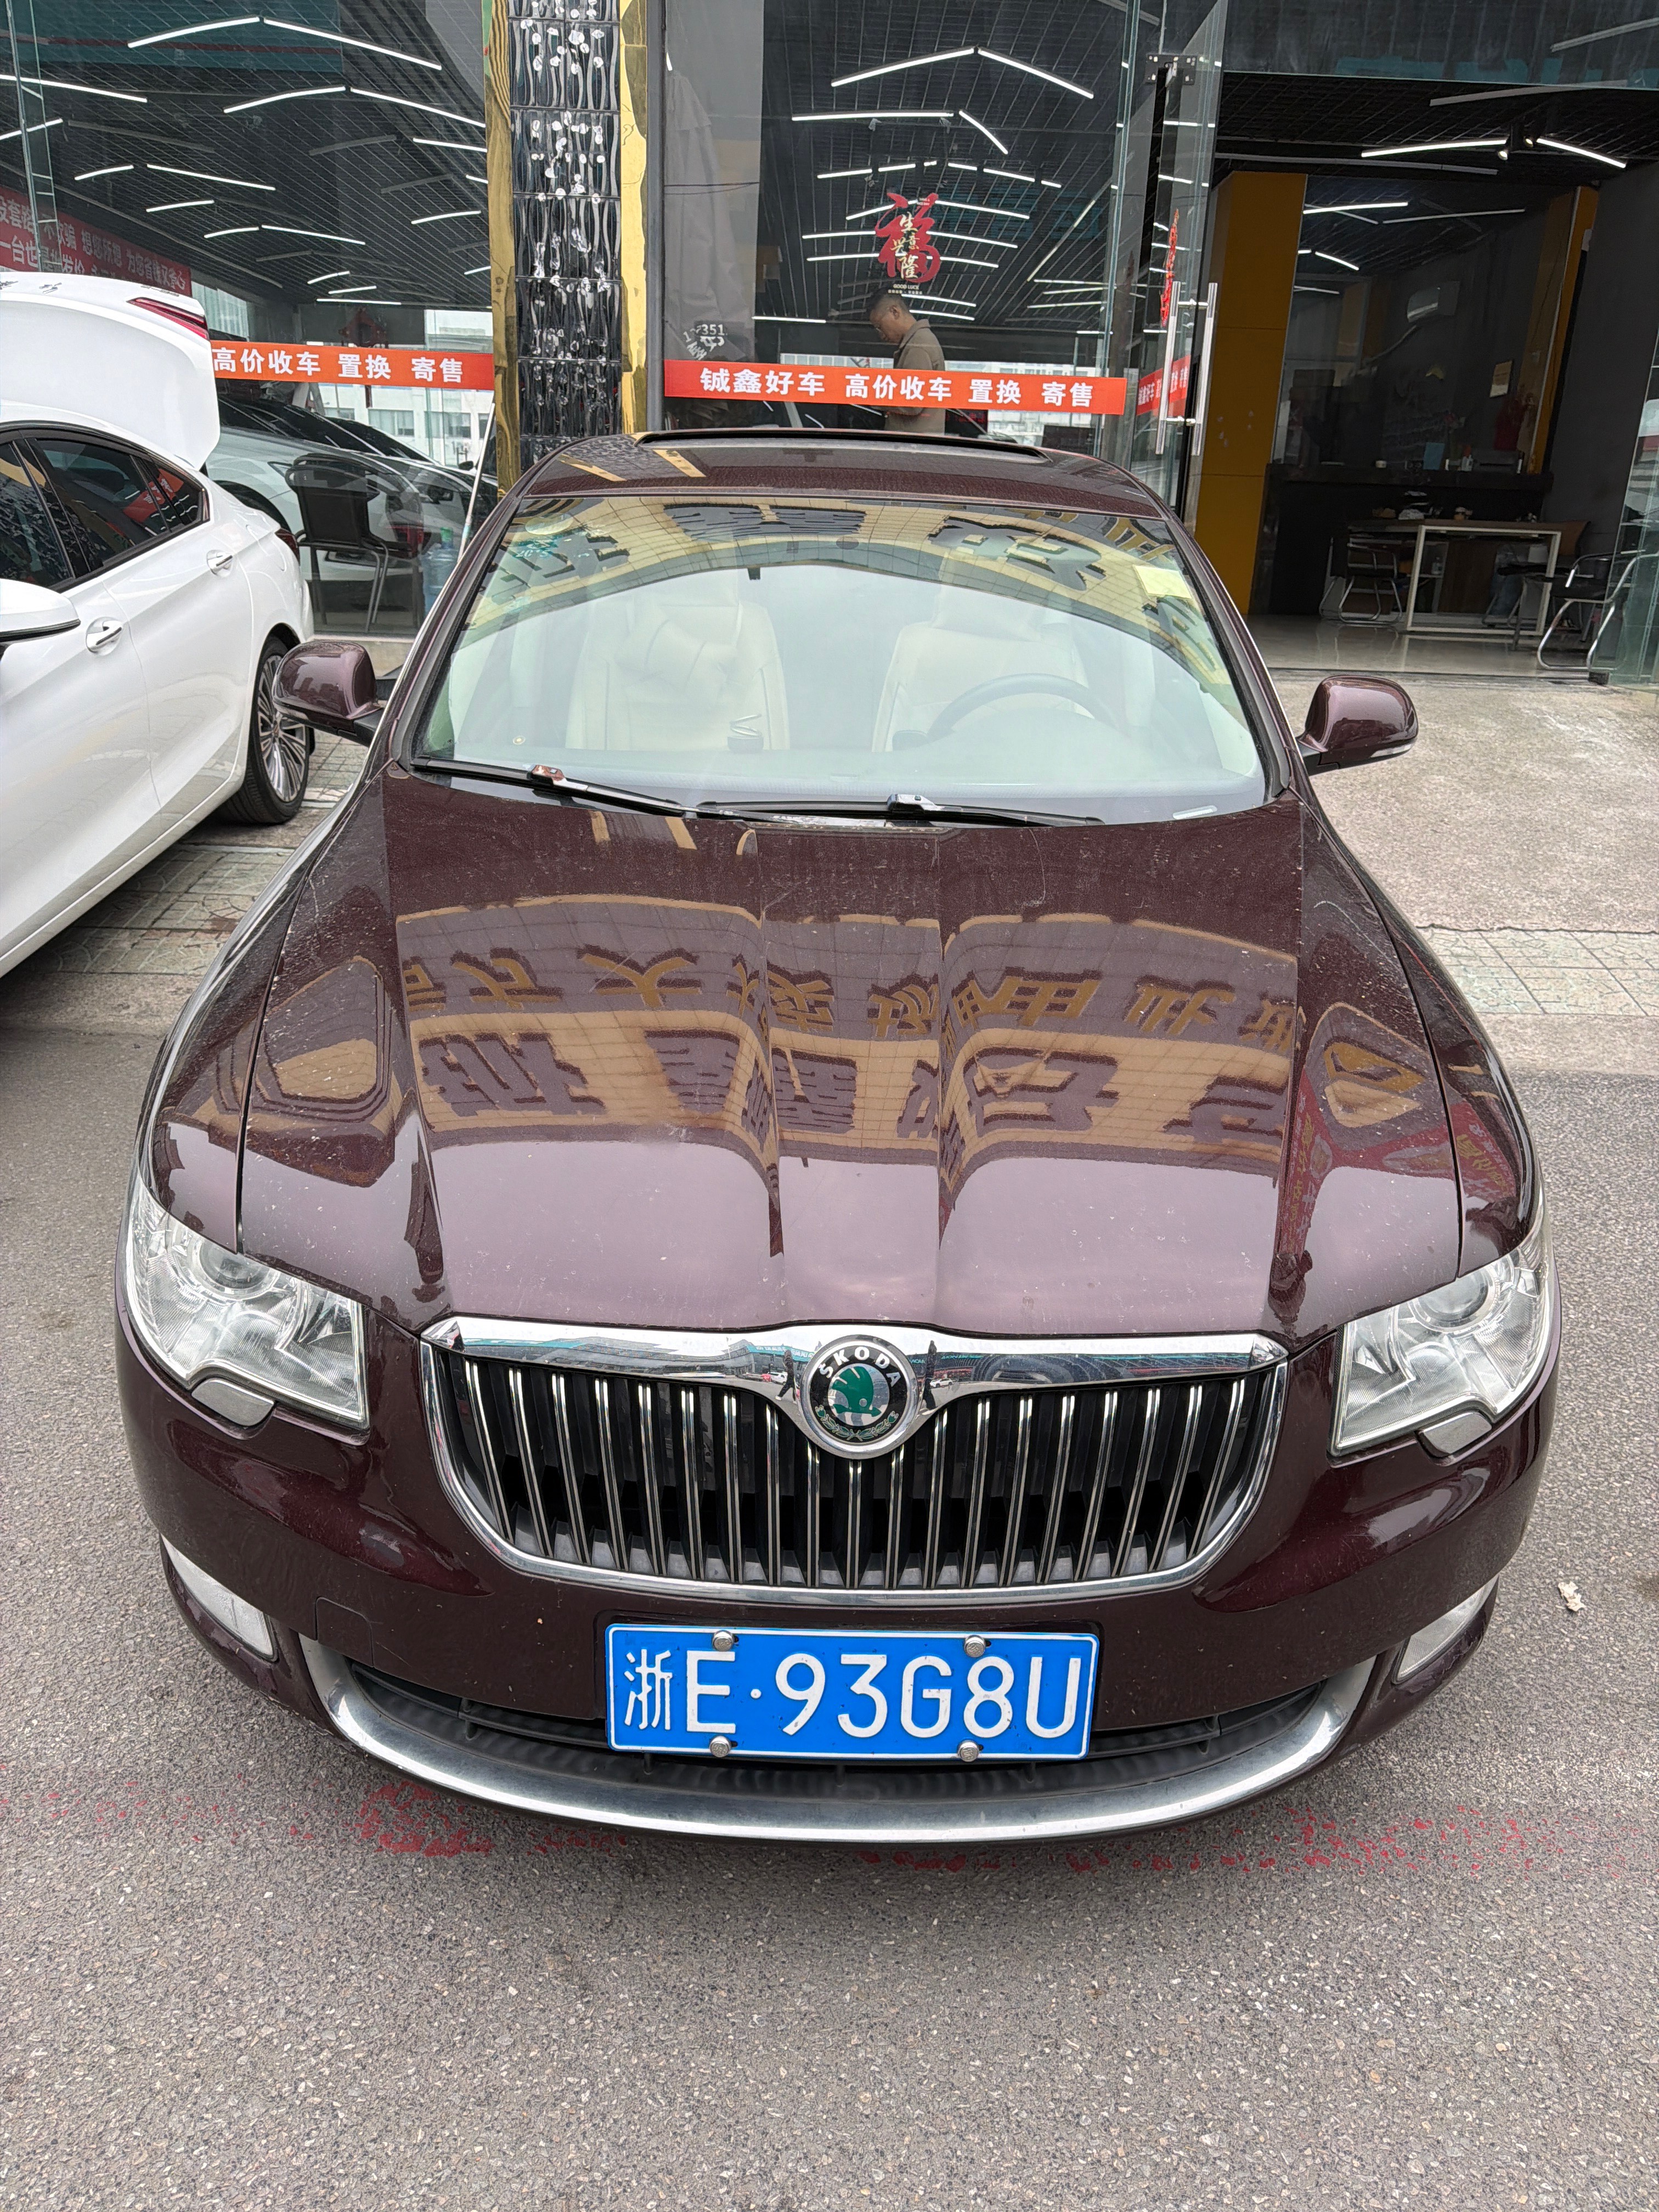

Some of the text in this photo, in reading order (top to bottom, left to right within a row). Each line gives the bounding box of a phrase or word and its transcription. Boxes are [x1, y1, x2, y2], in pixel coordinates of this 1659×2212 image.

[212, 347, 463, 383] 高价收车 置换 寄售
[699, 367, 1093, 407] 铖鑫好车 高价收车 置换 寄售
[624, 1649, 1081, 1739] 浙E·93G8U
